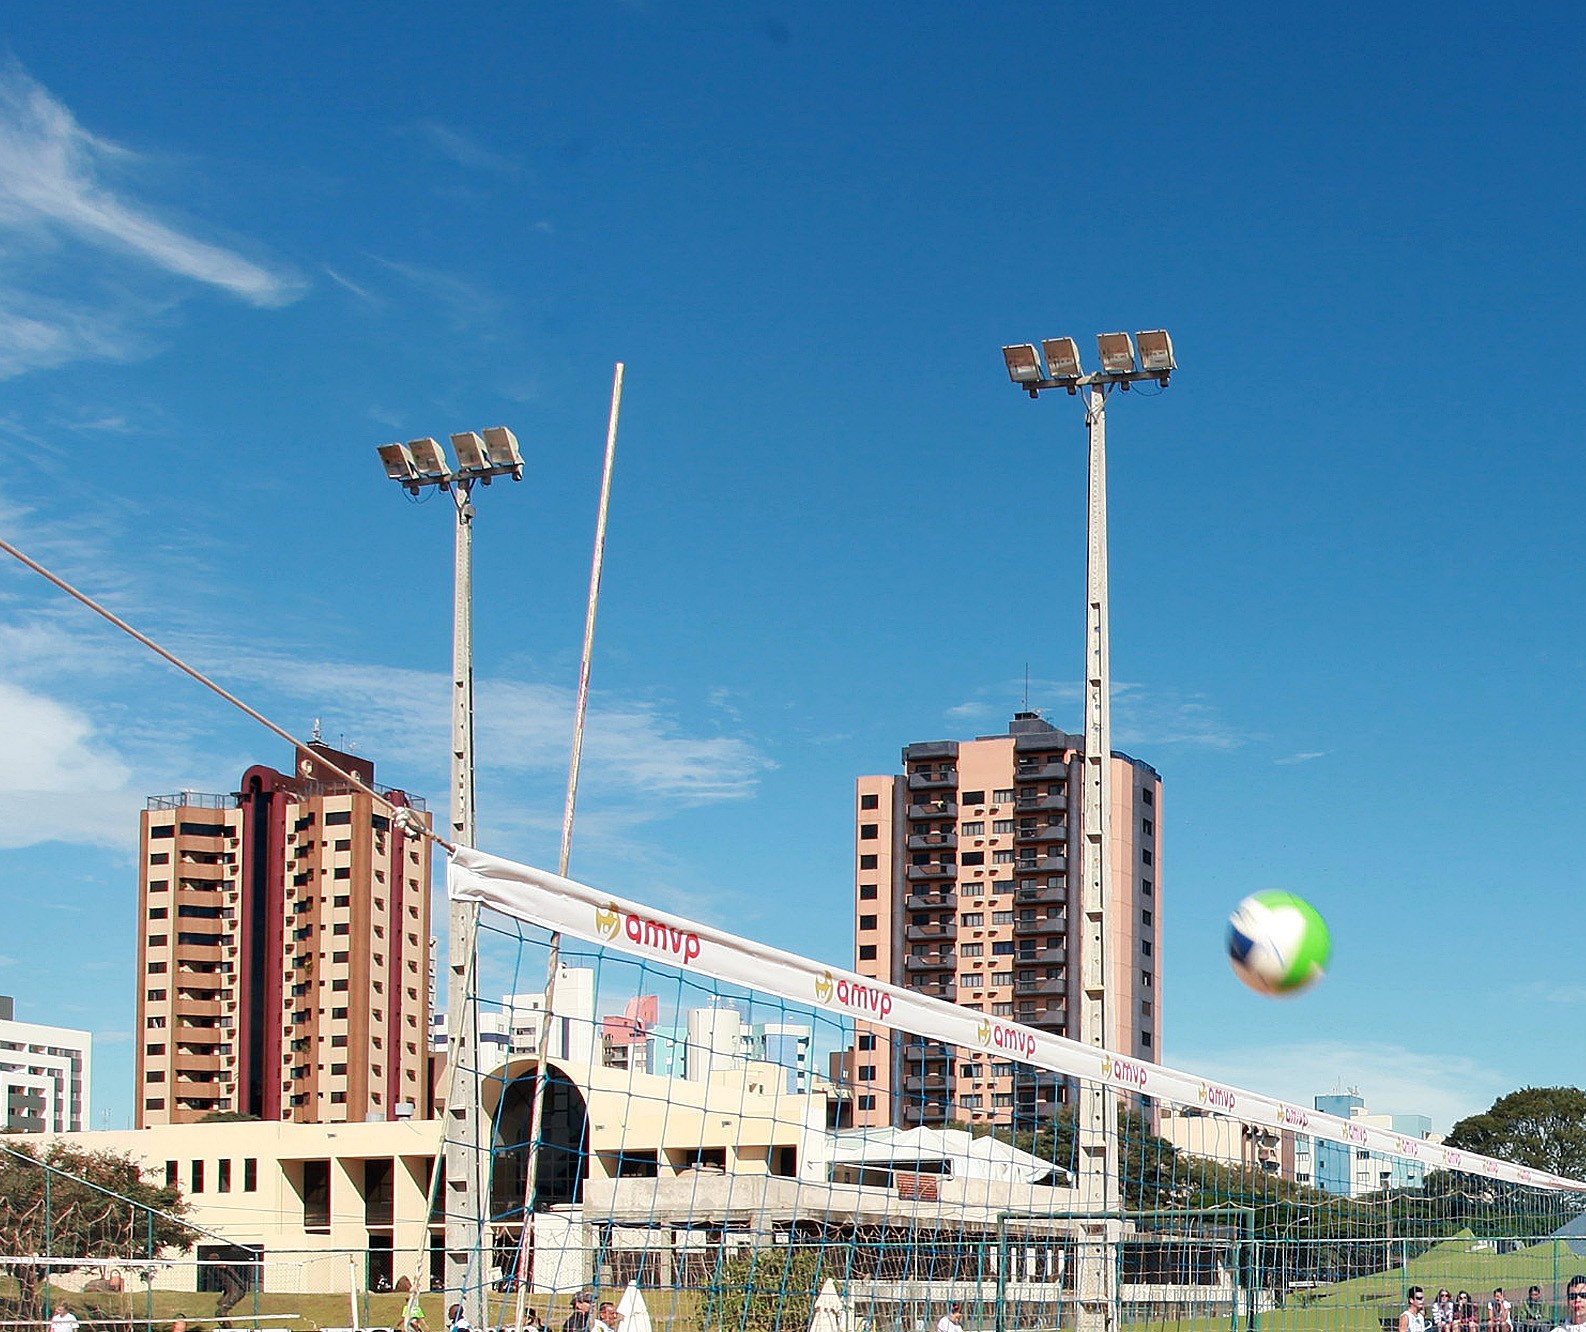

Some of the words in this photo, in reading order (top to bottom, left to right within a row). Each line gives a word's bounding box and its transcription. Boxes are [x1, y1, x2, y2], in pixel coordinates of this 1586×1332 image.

[626, 913, 700, 965] amvp
[837, 979, 892, 1020] amvp
[994, 1025, 1036, 1059] amvp
[1114, 1061, 1147, 1089] amvp
[1208, 1086, 1235, 1112] amvp
